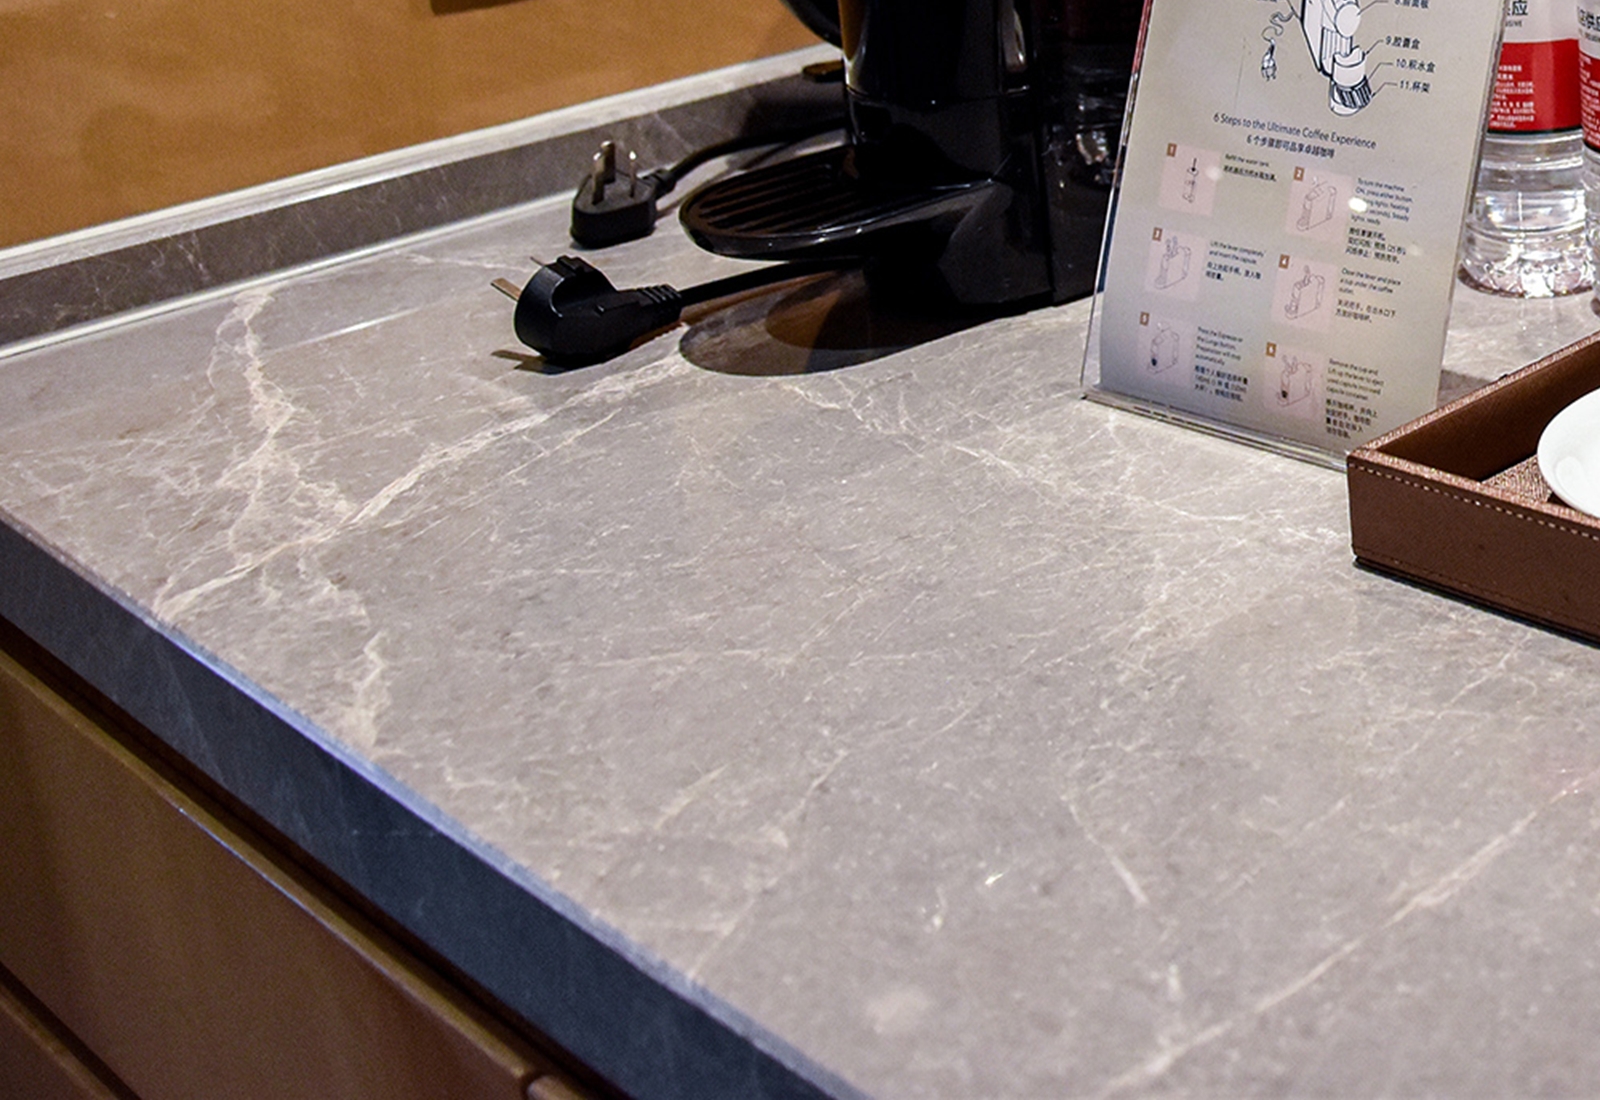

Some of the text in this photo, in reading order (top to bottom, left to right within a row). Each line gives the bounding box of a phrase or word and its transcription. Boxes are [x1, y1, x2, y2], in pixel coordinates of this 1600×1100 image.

[1213, 113, 1377, 150] 6 Steps to the Ultimate Coffee Experience
